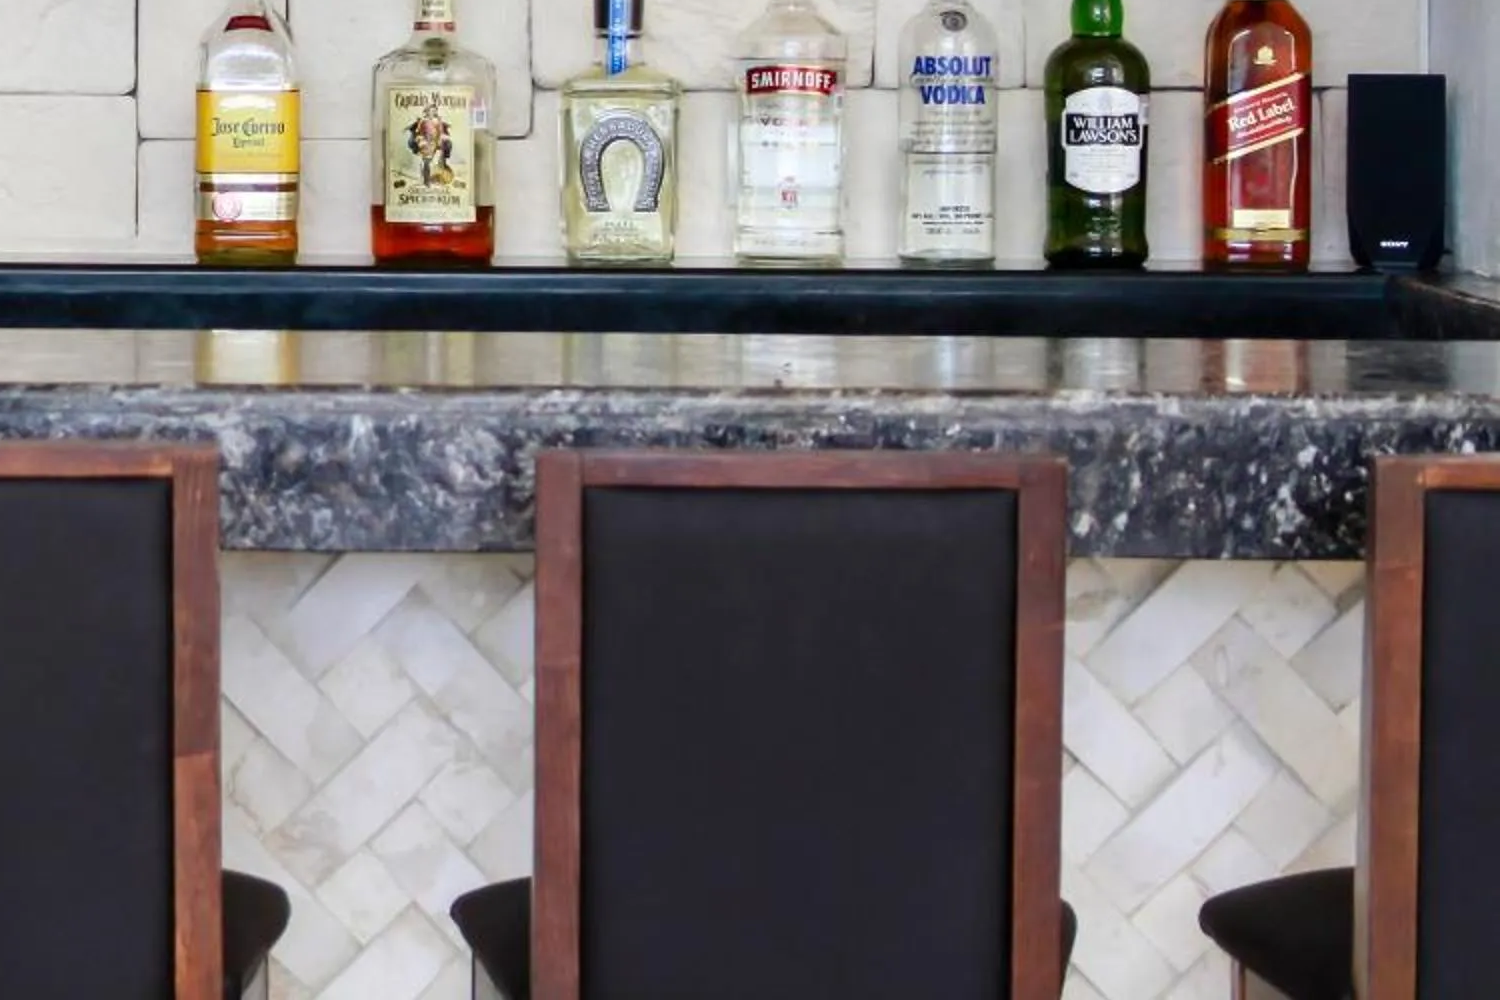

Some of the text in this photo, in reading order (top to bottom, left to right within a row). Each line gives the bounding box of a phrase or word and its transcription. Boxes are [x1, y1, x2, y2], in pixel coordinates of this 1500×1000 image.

[913, 55, 992, 77] ABSOLUT
[750, 70, 832, 90] SMIRNOFF
[919, 85, 986, 105] VODKA
[1072, 115, 1133, 129] WILLIAM
[1227, 97, 1296, 132] Red Label
[1069, 129, 1138, 143] LAWSON'S
